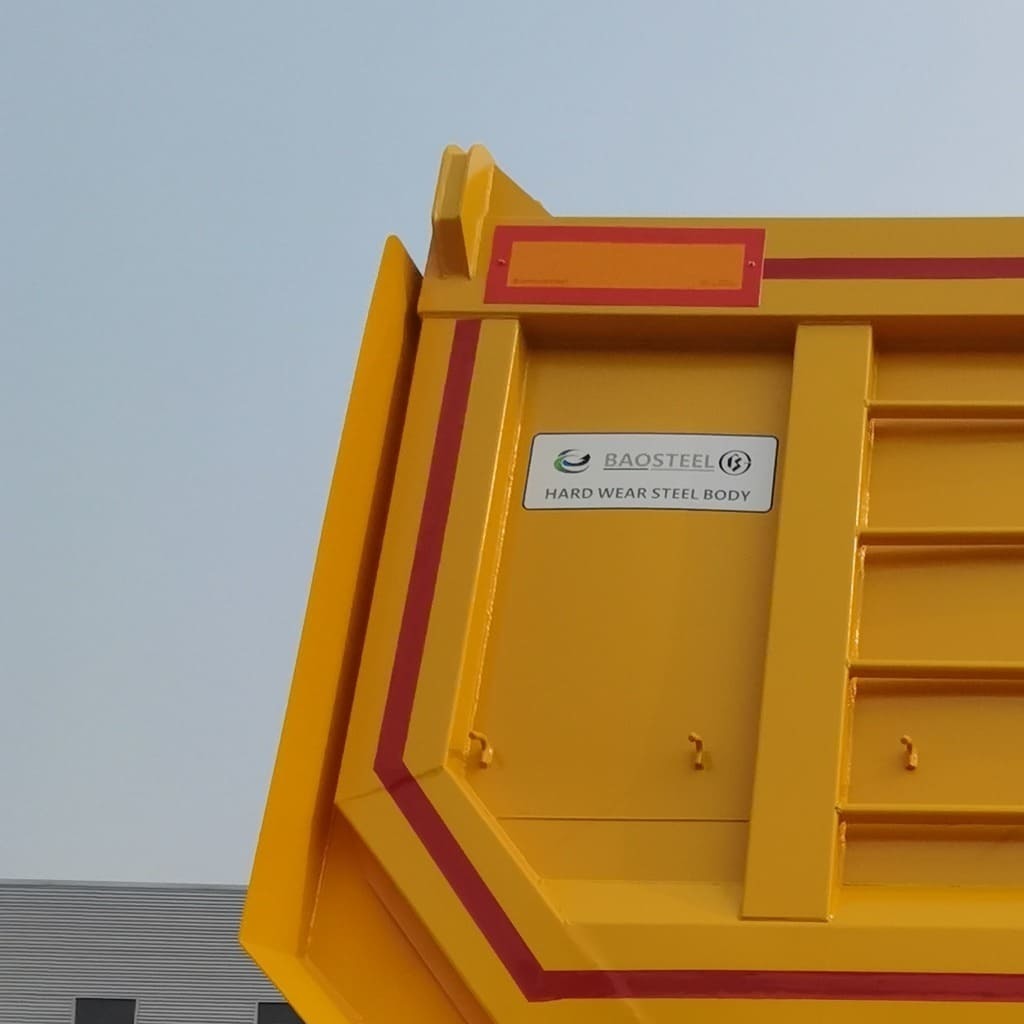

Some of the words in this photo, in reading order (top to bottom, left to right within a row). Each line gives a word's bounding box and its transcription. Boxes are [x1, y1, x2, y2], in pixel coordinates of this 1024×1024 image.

[604, 453, 715, 469] BAOSTEEL
[545, 487, 593, 500] HARD
[599, 487, 647, 500] WEAR
[651, 487, 699, 500] STEEL
[703, 489, 751, 501] BODY
